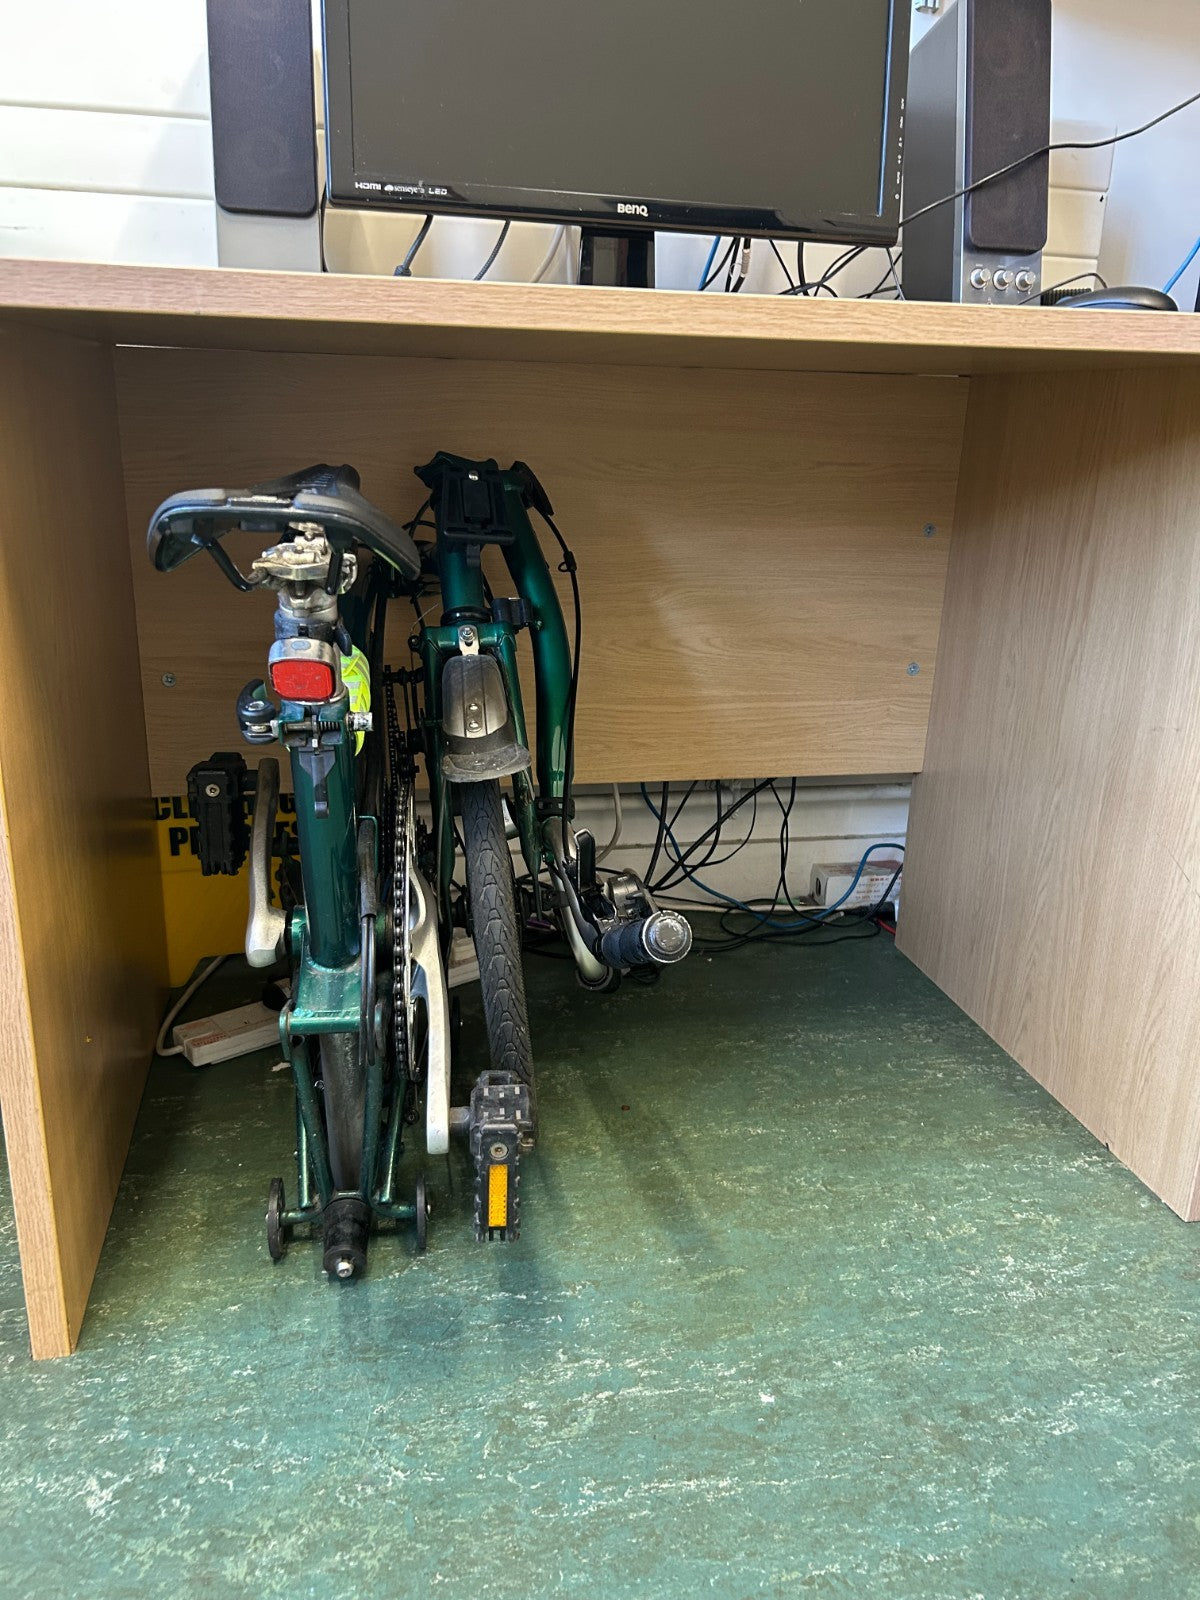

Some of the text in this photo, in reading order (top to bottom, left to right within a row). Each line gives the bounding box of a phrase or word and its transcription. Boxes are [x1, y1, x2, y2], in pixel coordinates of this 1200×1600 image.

[354, 181, 382, 191] HDMI
[428, 187, 448, 195] LED
[617, 203, 649, 217] BenQ
